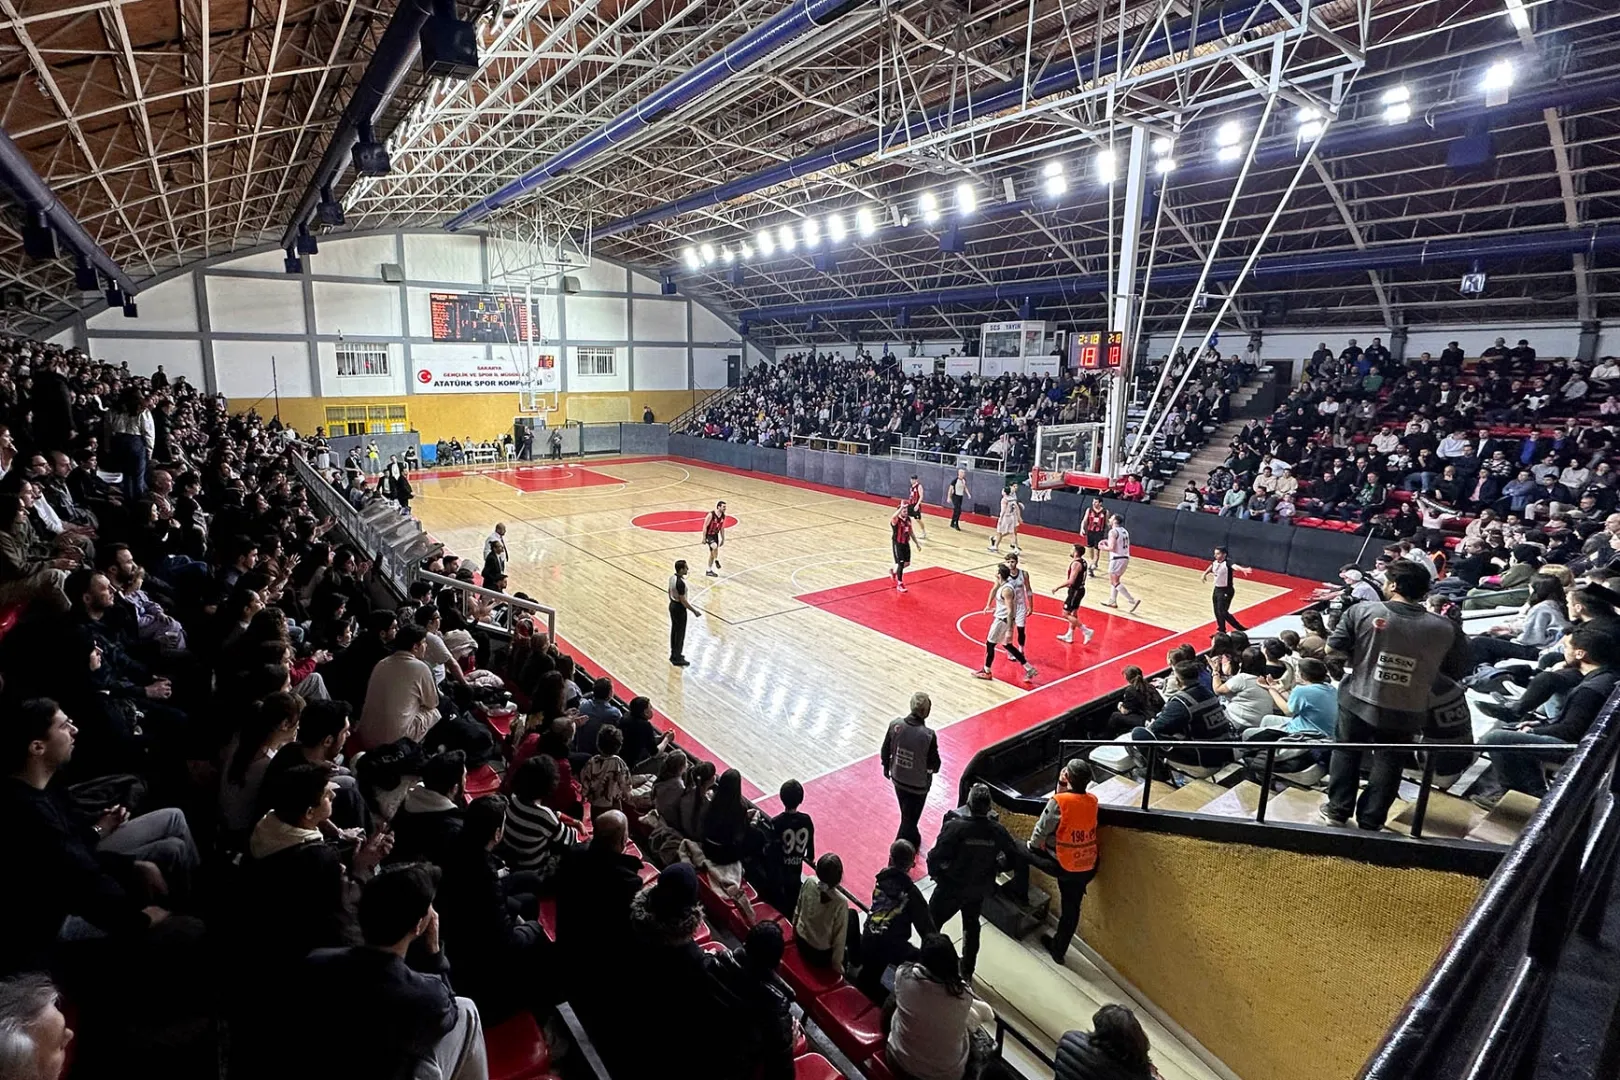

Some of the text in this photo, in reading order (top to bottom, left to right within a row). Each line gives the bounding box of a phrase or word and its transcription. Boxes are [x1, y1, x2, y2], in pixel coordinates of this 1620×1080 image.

[482, 314, 497, 323] 2:18
[1078, 333, 1100, 345] 2:18
[1080, 347, 1097, 366] 18
[1109, 346, 1119, 365] 18
[1380, 655, 1414, 668] BASIN
[782, 828, 809, 854] 99
